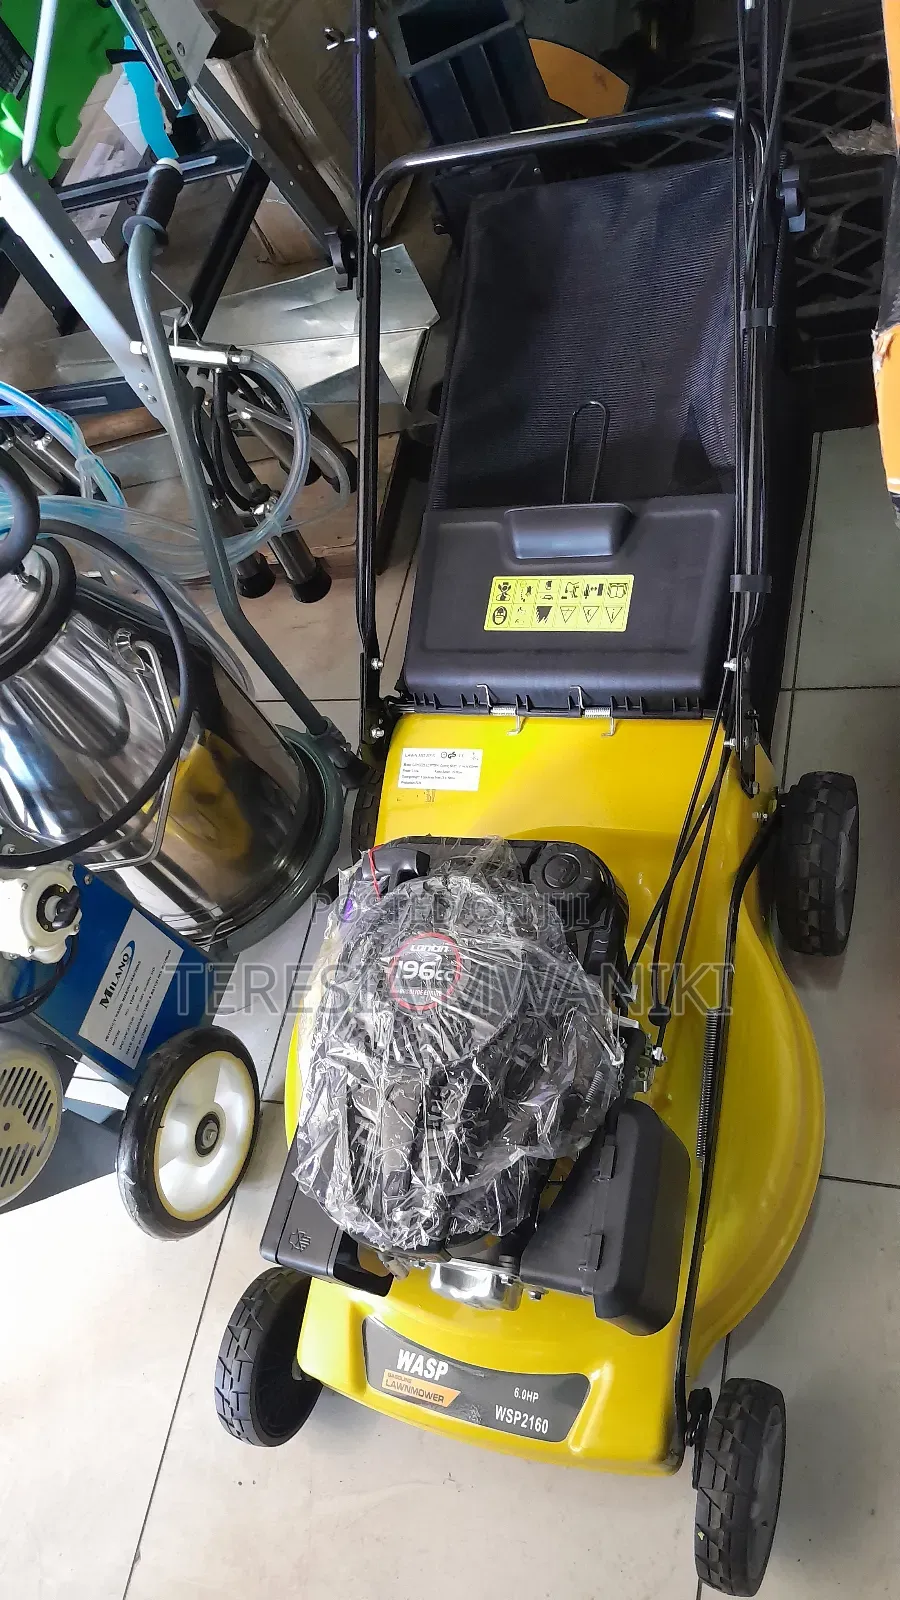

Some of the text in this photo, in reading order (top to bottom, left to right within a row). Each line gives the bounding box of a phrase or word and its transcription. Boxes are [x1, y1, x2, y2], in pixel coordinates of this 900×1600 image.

[99, 953, 129, 1009] MILANO
[396, 1349, 449, 1381] WASP
[385, 1379, 445, 1404] LAWNMOWER
[514, 1387, 539, 1404] 6.0HP
[495, 1404, 549, 1435] WSP2160
